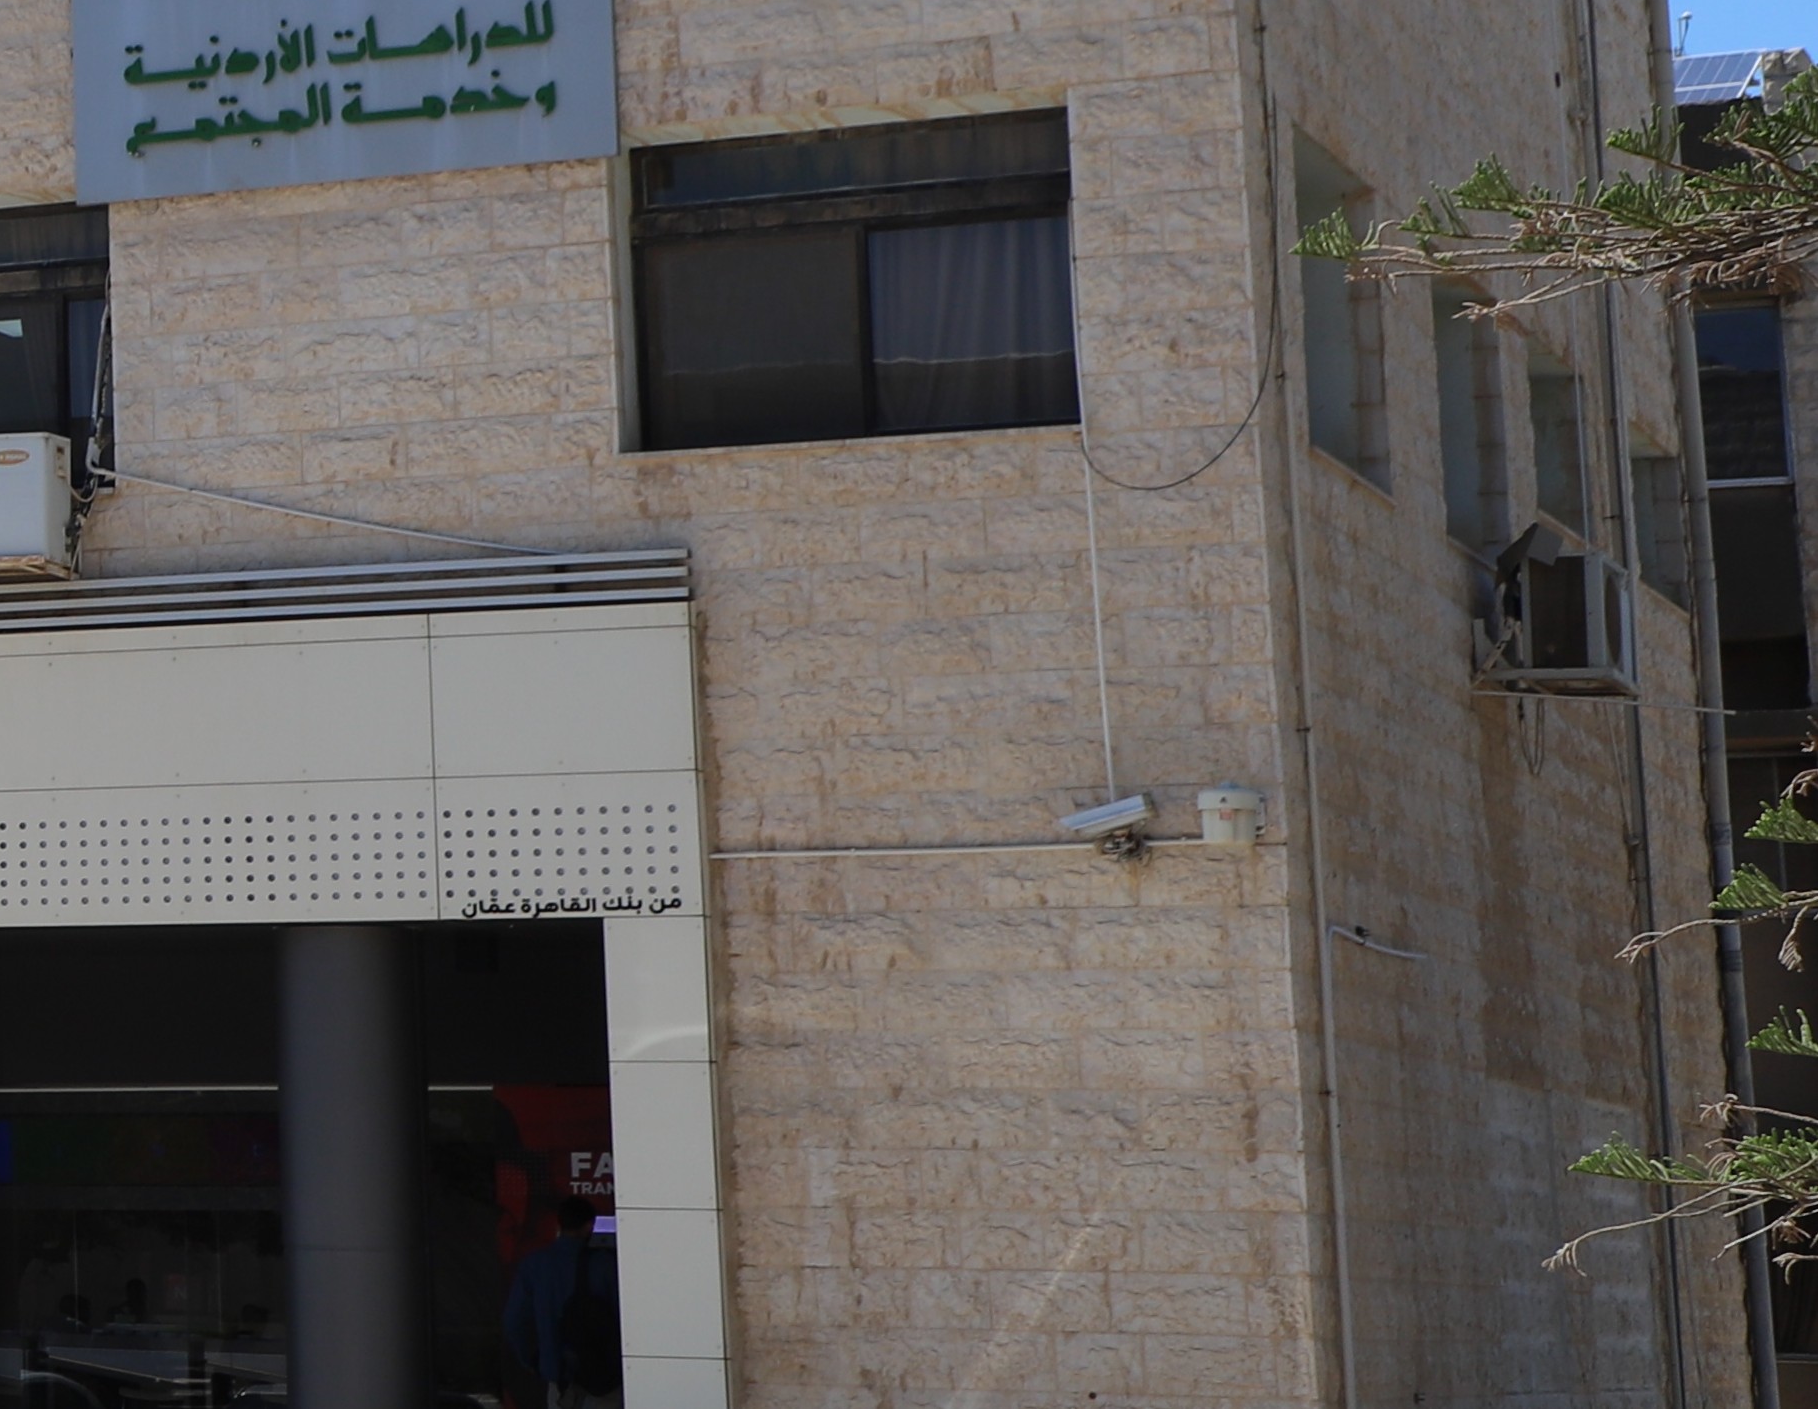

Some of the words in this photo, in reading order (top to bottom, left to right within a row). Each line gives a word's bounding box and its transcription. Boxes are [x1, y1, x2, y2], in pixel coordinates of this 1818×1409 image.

[123, 18, 315, 89] الأردنية
[126, 82, 330, 158] المجتمع
[520, 896, 596, 918] القاهرة
[602, 895, 642, 914] بنك
